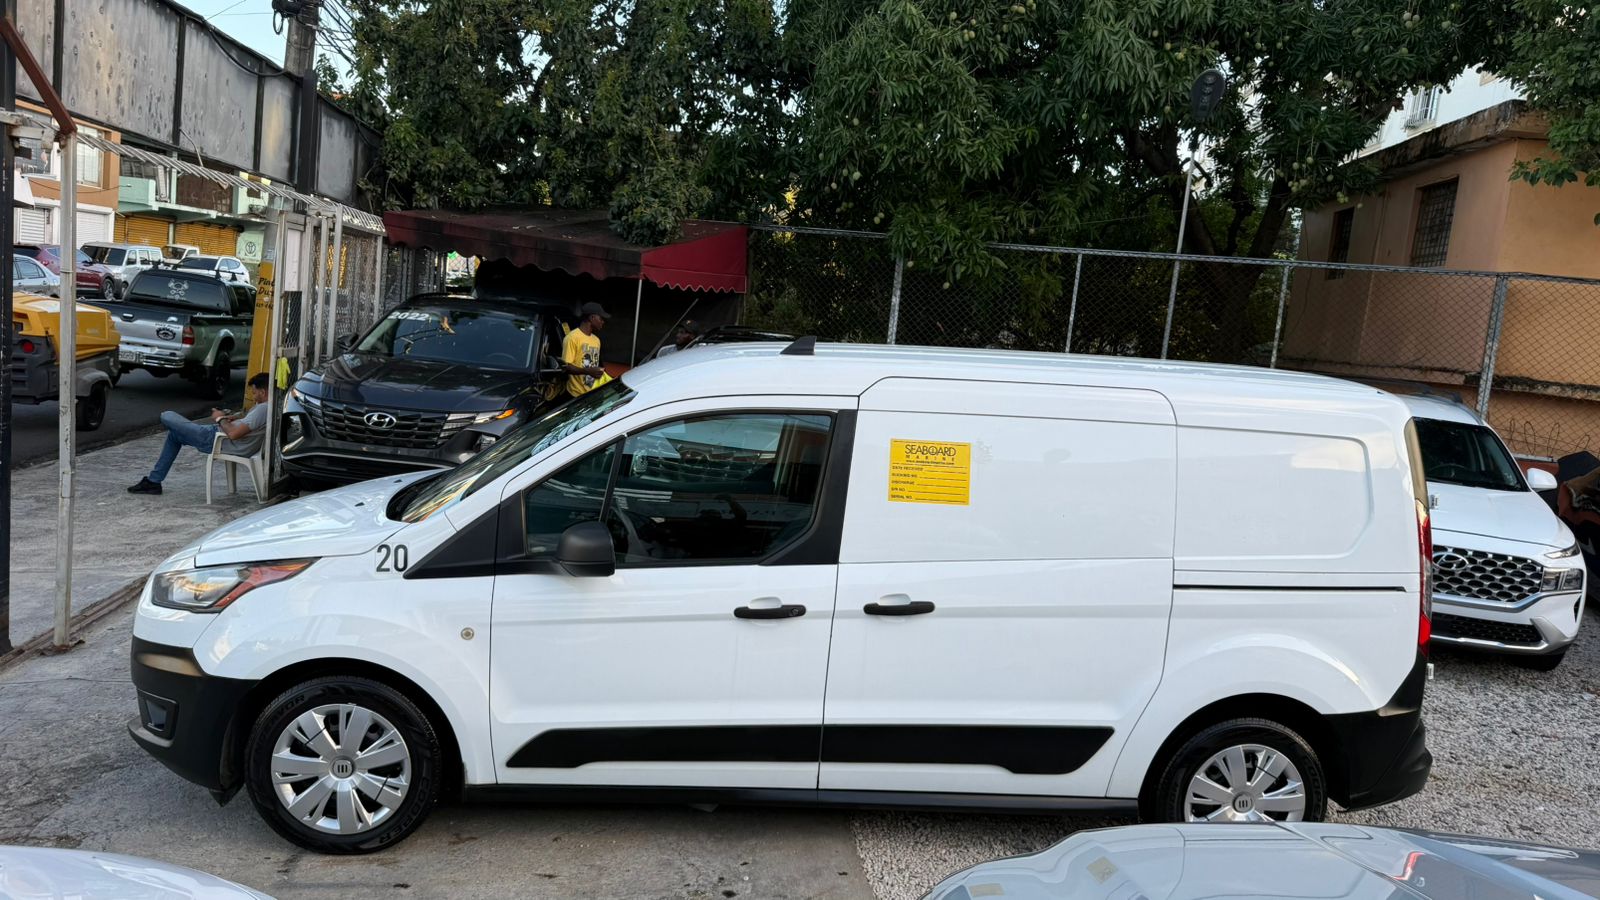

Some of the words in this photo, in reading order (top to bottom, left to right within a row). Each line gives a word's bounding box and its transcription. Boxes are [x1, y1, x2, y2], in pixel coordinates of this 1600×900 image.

[387, 311, 430, 321] 2022
[904, 444, 957, 457] SEABOARD
[376, 544, 408, 572] 20
